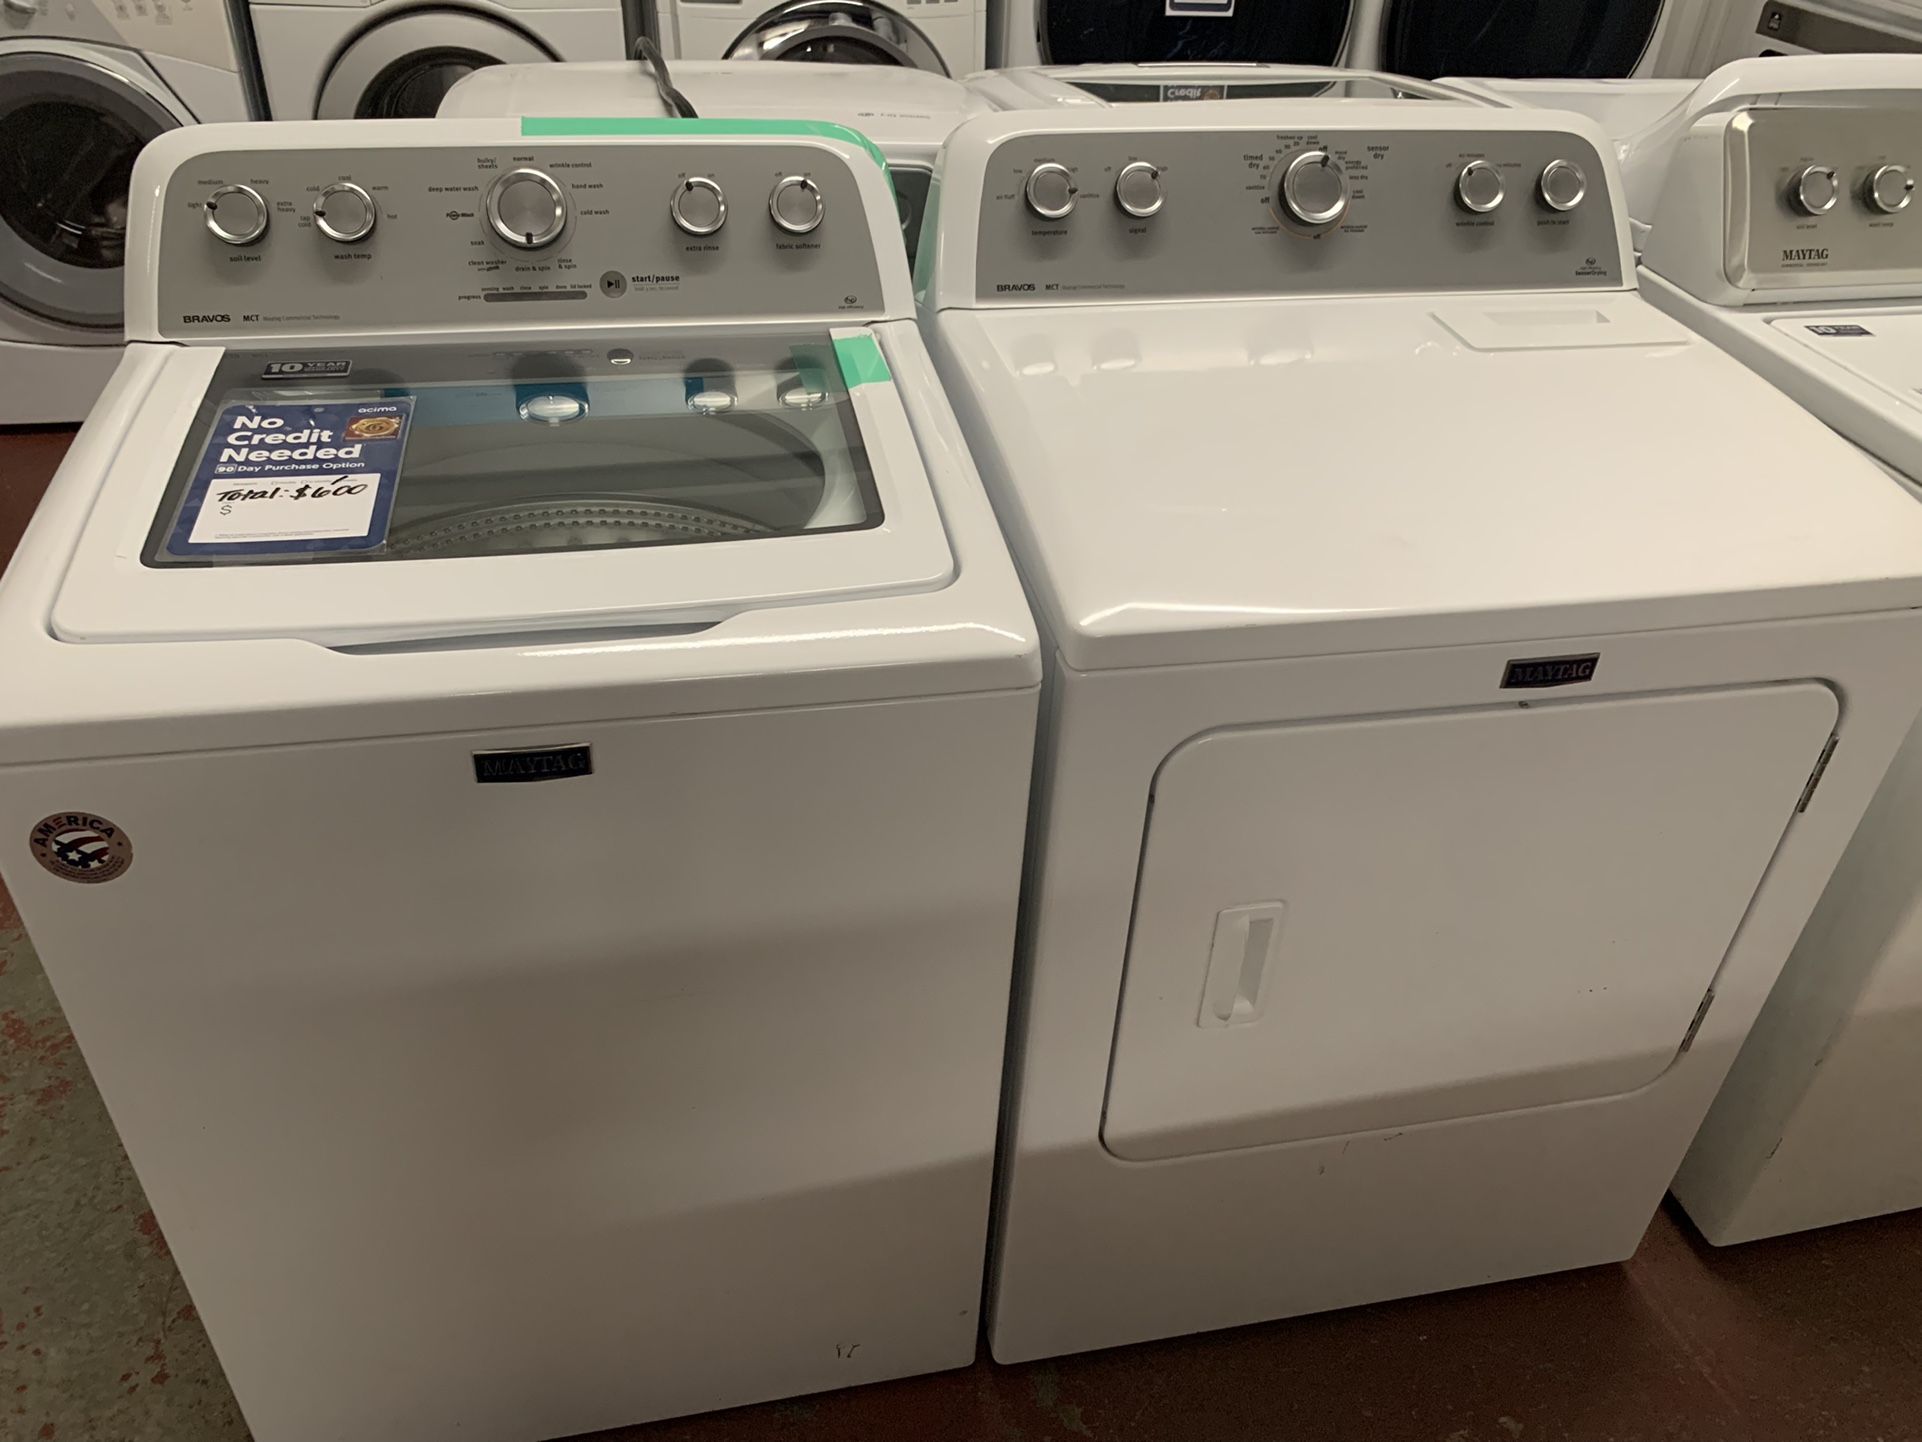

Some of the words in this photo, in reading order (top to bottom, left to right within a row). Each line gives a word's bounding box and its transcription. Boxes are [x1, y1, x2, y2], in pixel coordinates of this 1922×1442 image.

[1248, 162, 1260, 170] dry
[1031, 229, 1068, 237] temperature
[1128, 227, 1147, 235] signal
[353, 253, 372, 261] temp
[1782, 249, 1829, 262] MAYTAG
[632, 274, 680, 284] start/pause
[996, 284, 1036, 292] BRAVOS
[183, 315, 231, 324] BRAVOS
[270, 363, 303, 373] 10
[233, 416, 284, 429] No
[227, 429, 333, 446] Credit
[219, 445, 362, 463] Needed
[237, 465, 261, 473] Day
[322, 462, 365, 470] Option
[1511, 662, 1592, 683] MAYTAG
[483, 754, 586, 776] MAYTAG
[33, 816, 115, 848] AMERICA
